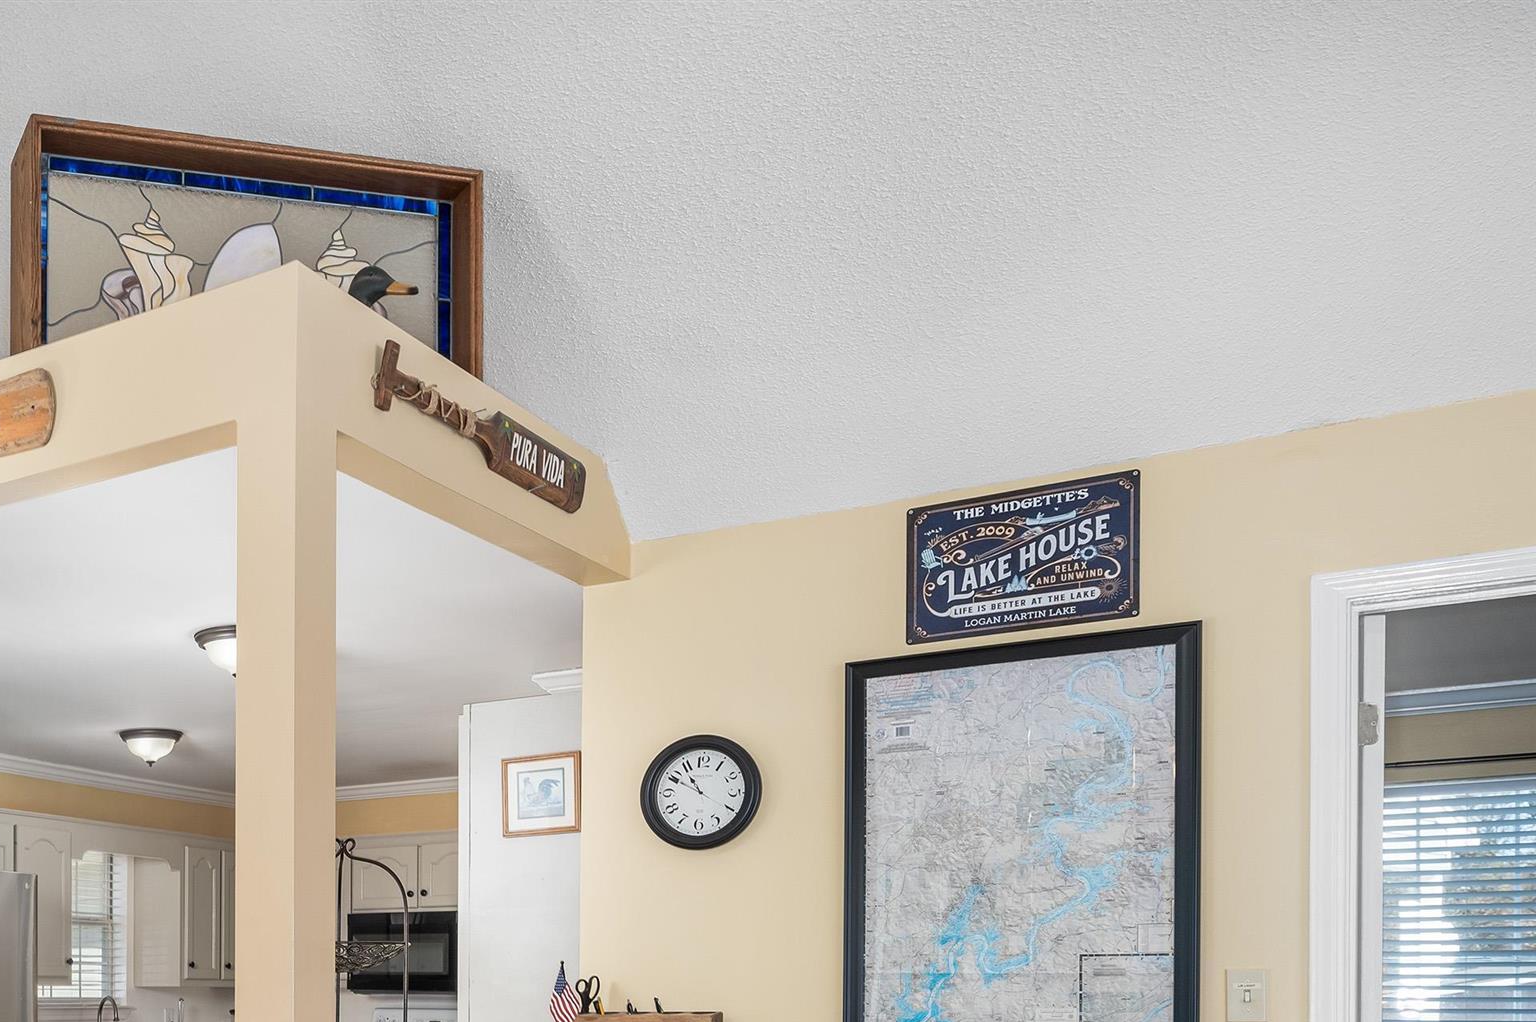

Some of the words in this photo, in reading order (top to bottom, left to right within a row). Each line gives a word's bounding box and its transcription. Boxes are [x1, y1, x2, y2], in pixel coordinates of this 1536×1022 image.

[510, 432, 539, 475] PURA
[541, 449, 565, 489] VIDA
[953, 503, 985, 521] THE
[990, 488, 1089, 516] MIDGETTE'S
[940, 530, 974, 552] EST.
[976, 525, 1015, 539] 2009
[937, 552, 1012, 603] LAKE
[1018, 513, 1111, 573] HOUSE
[1054, 561, 1088, 574] RELAX
[1036, 575, 1057, 585] AND
[1060, 568, 1104, 582] UNWIND
[954, 605, 974, 616] LIFE
[977, 603, 987, 613] IS
[991, 599, 1027, 611] BETTER
[1031, 596, 1042, 605] AT
[1047, 593, 1066, 603] THE
[1070, 589, 1096, 600] LAKE
[964, 615, 1001, 628] LOGAN
[1003, 609, 1046, 623] MARTIN
[1049, 605, 1077, 617] LAKE
[682, 760, 693, 773] 11
[697, 755, 710, 768] 12
[715, 760, 724, 771] 1
[724, 771, 738, 783] 2
[662, 788, 675, 798] 9
[665, 803, 679, 814] 8
[678, 813, 688, 825] 7
[694, 818, 704, 831] 6
[710, 813, 720, 827] 5
